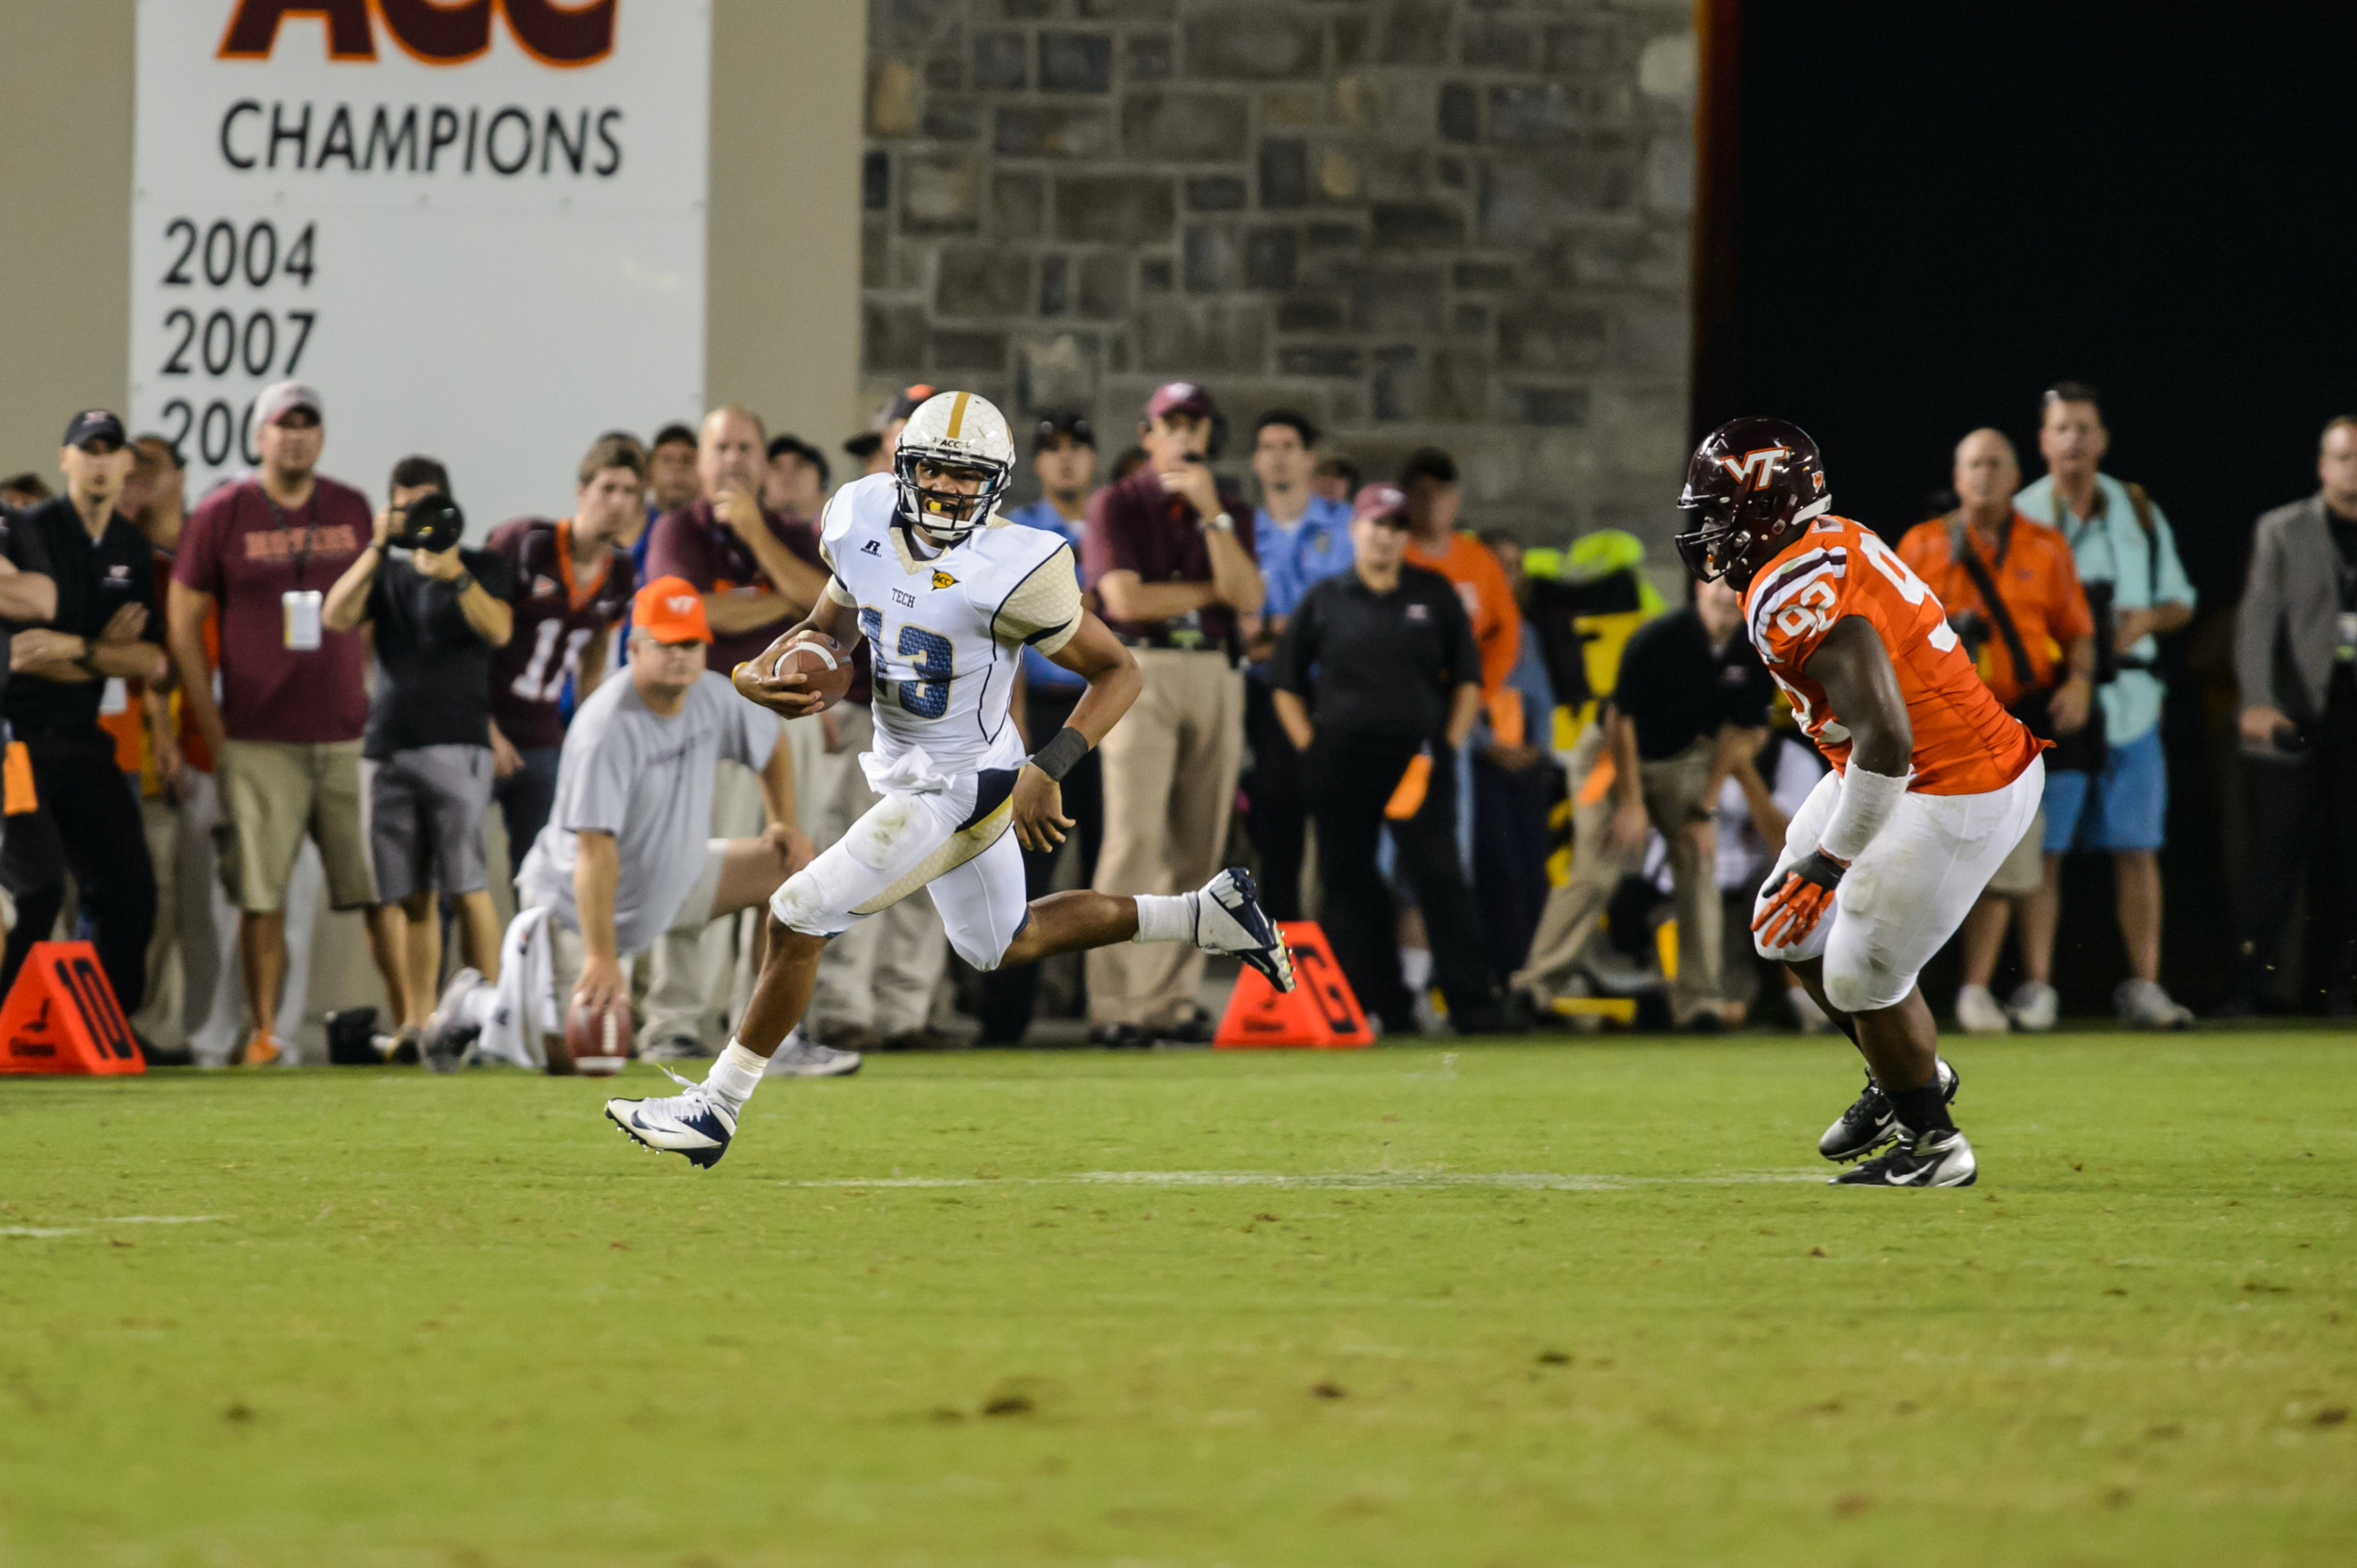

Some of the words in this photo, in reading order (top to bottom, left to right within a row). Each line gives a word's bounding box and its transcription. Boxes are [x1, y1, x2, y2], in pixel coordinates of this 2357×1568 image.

[220, 99, 624, 177] CHAMPIONS
[161, 218, 317, 287] 2004
[160, 308, 318, 377] 2007
[940, 438, 961, 448] ACC
[1721, 446, 1789, 492] VT
[891, 587, 915, 609] TECH
[933, 574, 950, 586] ACC
[1777, 581, 1838, 638] 92
[857, 603, 956, 721] 13
[54, 958, 134, 1060] 10
[1293, 946, 1359, 1033] G
